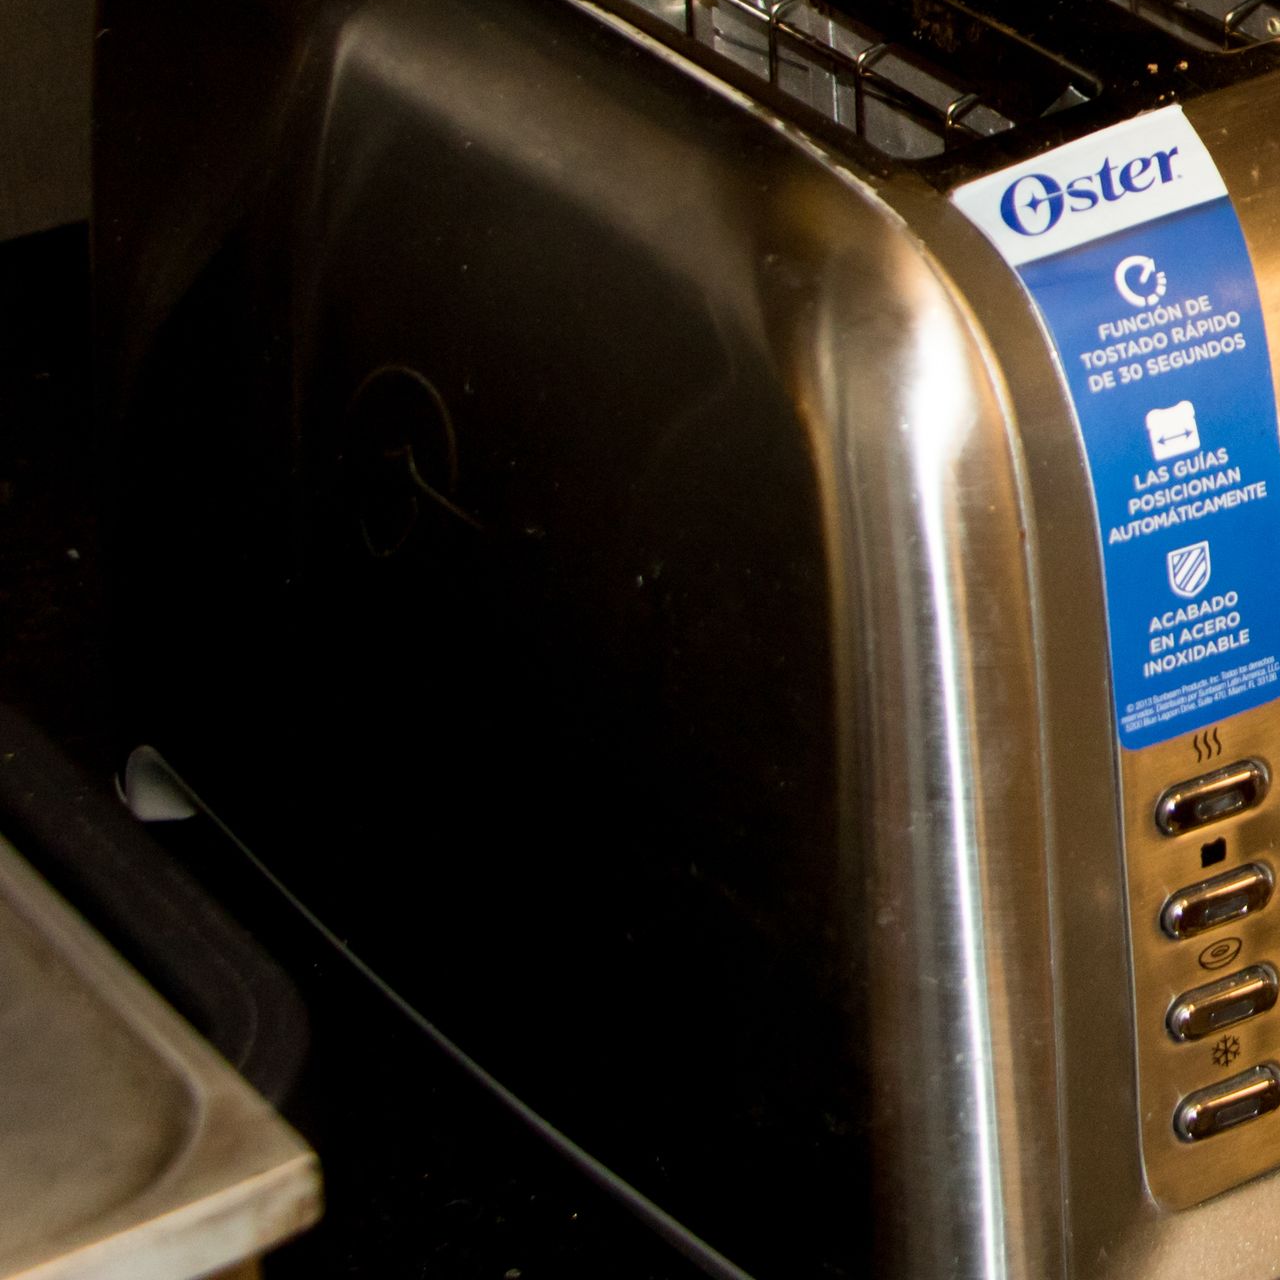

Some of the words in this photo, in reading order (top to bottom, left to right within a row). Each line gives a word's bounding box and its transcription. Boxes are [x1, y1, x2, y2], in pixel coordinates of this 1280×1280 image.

[1000, 147, 1178, 236] Oster
[1080, 331, 1168, 370] TOSTADO
[1171, 311, 1240, 344] RÁPIDO
[1099, 302, 1183, 341] FUNCIÓN
[1187, 295, 1212, 318] DE
[1089, 370, 1114, 392] DE
[1120, 363, 1143, 384] 30
[1148, 334, 1246, 376] SEGUNDOS
[1128, 467, 1241, 515] POSICIONAN
[1135, 467, 1169, 490] LAS
[1174, 448, 1228, 479] GUÍAS
[1109, 481, 1267, 544] AUTOMÁTICAMENTE
[1150, 591, 1238, 632] ACABADO
[1151, 634, 1174, 654] EN
[1180, 612, 1240, 644] ACERO
[1144, 630, 1249, 677] INOXIDABLE
